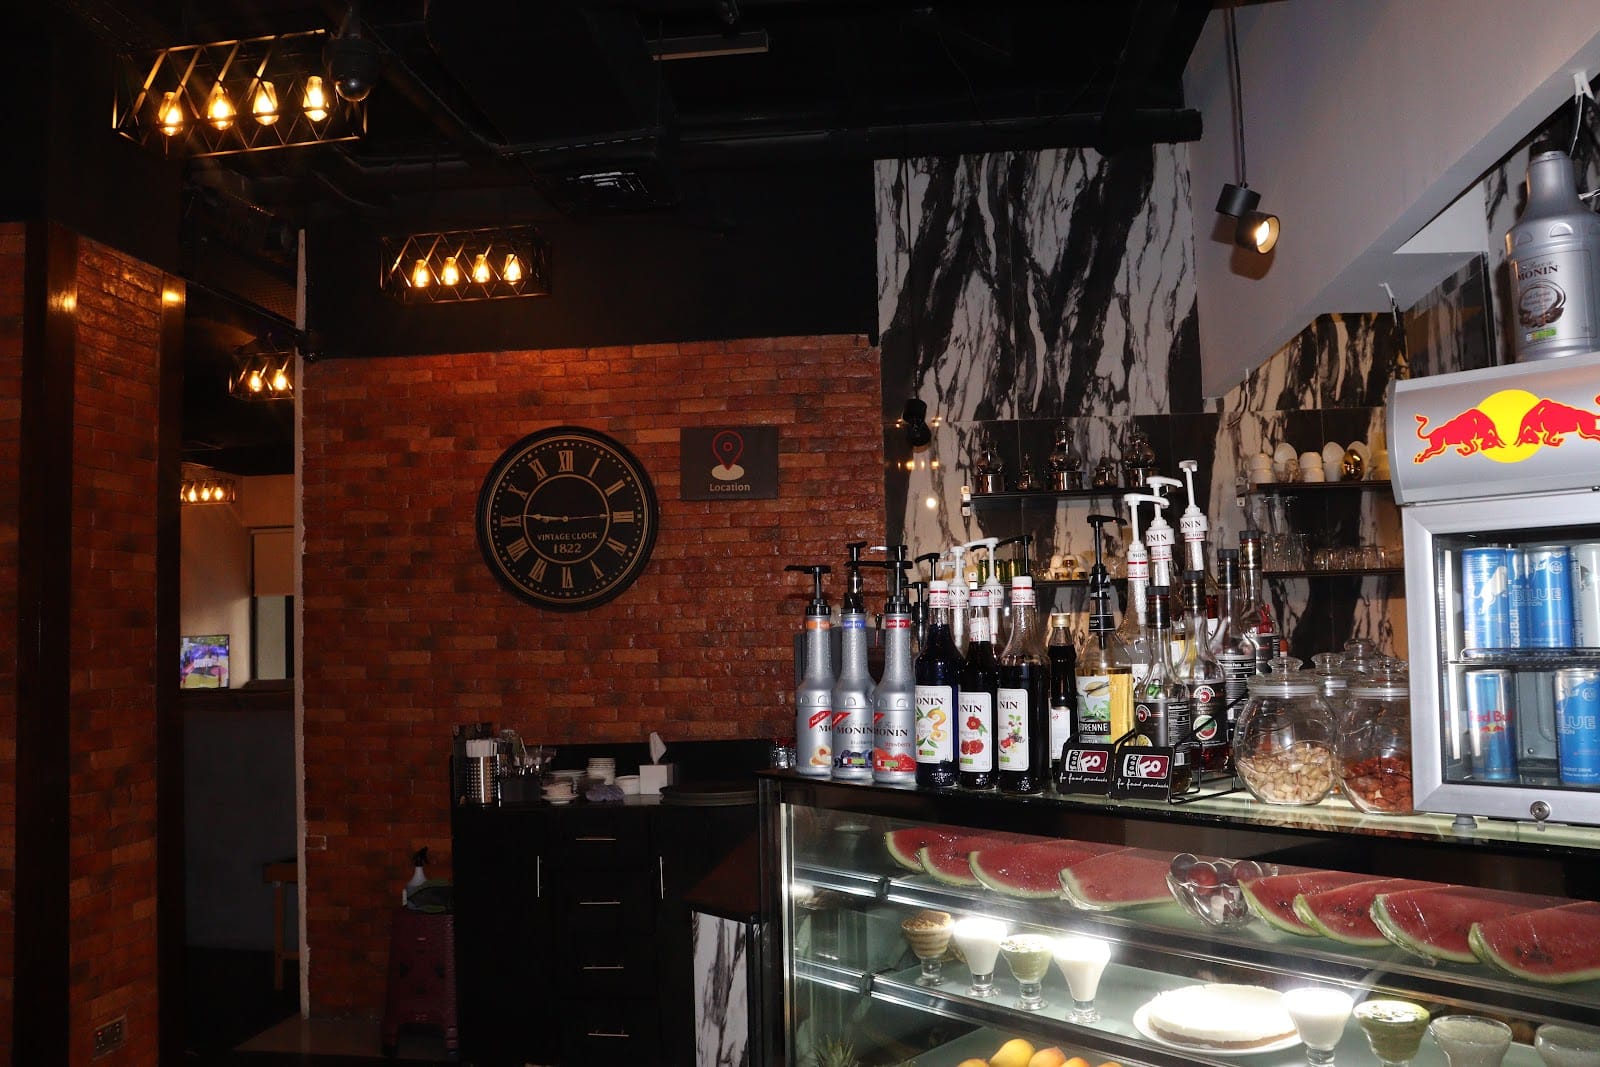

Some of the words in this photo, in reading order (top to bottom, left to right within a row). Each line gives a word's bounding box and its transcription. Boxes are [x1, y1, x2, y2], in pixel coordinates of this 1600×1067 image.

[1518, 264, 1558, 281] MONIN
[709, 482, 751, 492] Location
[537, 533, 570, 541] VINTAGE
[571, 532, 598, 540] CLOCK
[553, 543, 582, 554] 1822
[1512, 588, 1562, 601] BLUE
[1509, 609, 1520, 628] Bull
